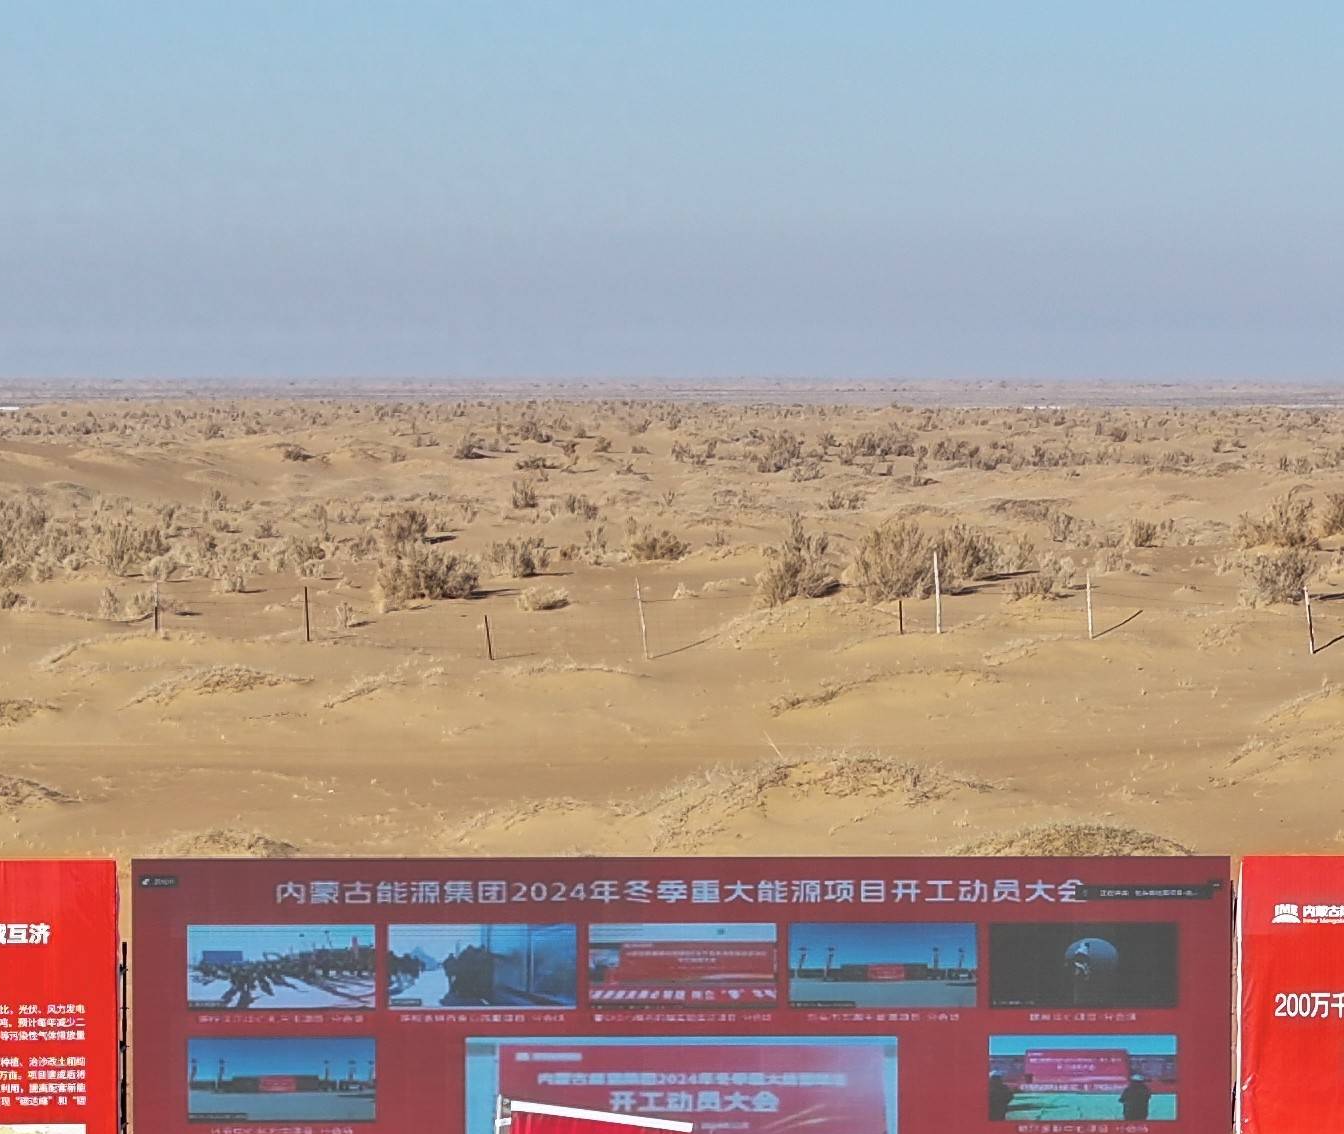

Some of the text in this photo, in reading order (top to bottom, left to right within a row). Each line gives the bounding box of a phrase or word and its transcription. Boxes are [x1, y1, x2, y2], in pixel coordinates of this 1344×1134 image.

[276, 879, 1088, 905] 内蒙古能源集团2024年冬季重大能源项目开工动员大会
[609, 1090, 780, 1114] 开工动员大会
